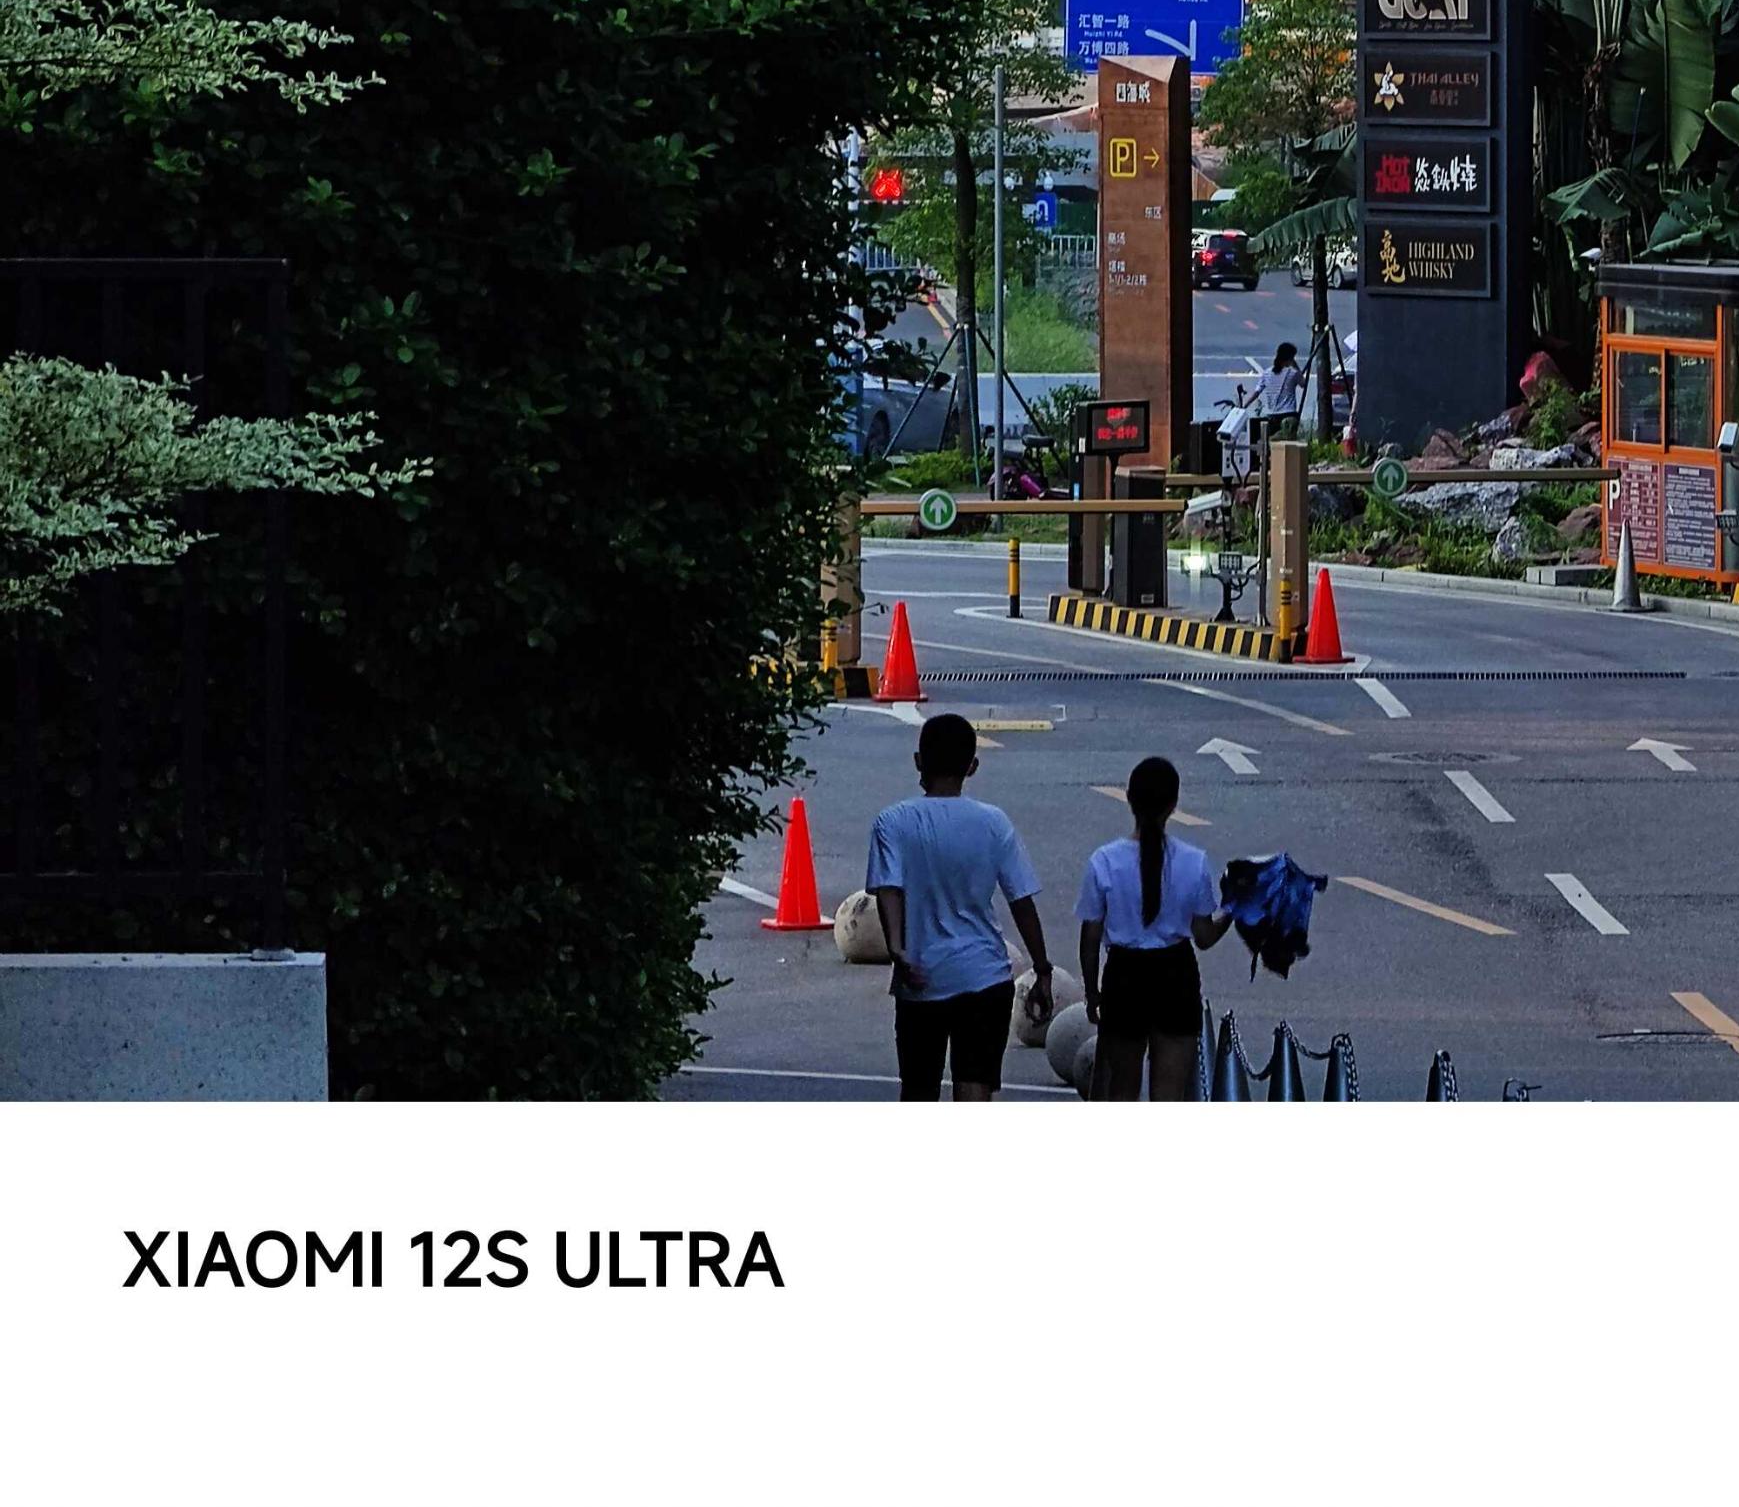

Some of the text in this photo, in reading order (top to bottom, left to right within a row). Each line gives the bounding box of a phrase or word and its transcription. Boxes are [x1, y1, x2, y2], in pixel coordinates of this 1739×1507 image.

[1078, 13, 1130, 29] 汇智一路
[1078, 40, 1130, 57] 万博四路
[1408, 241, 1475, 260] HIGHLAND
[1408, 260, 1456, 280] WHISKY
